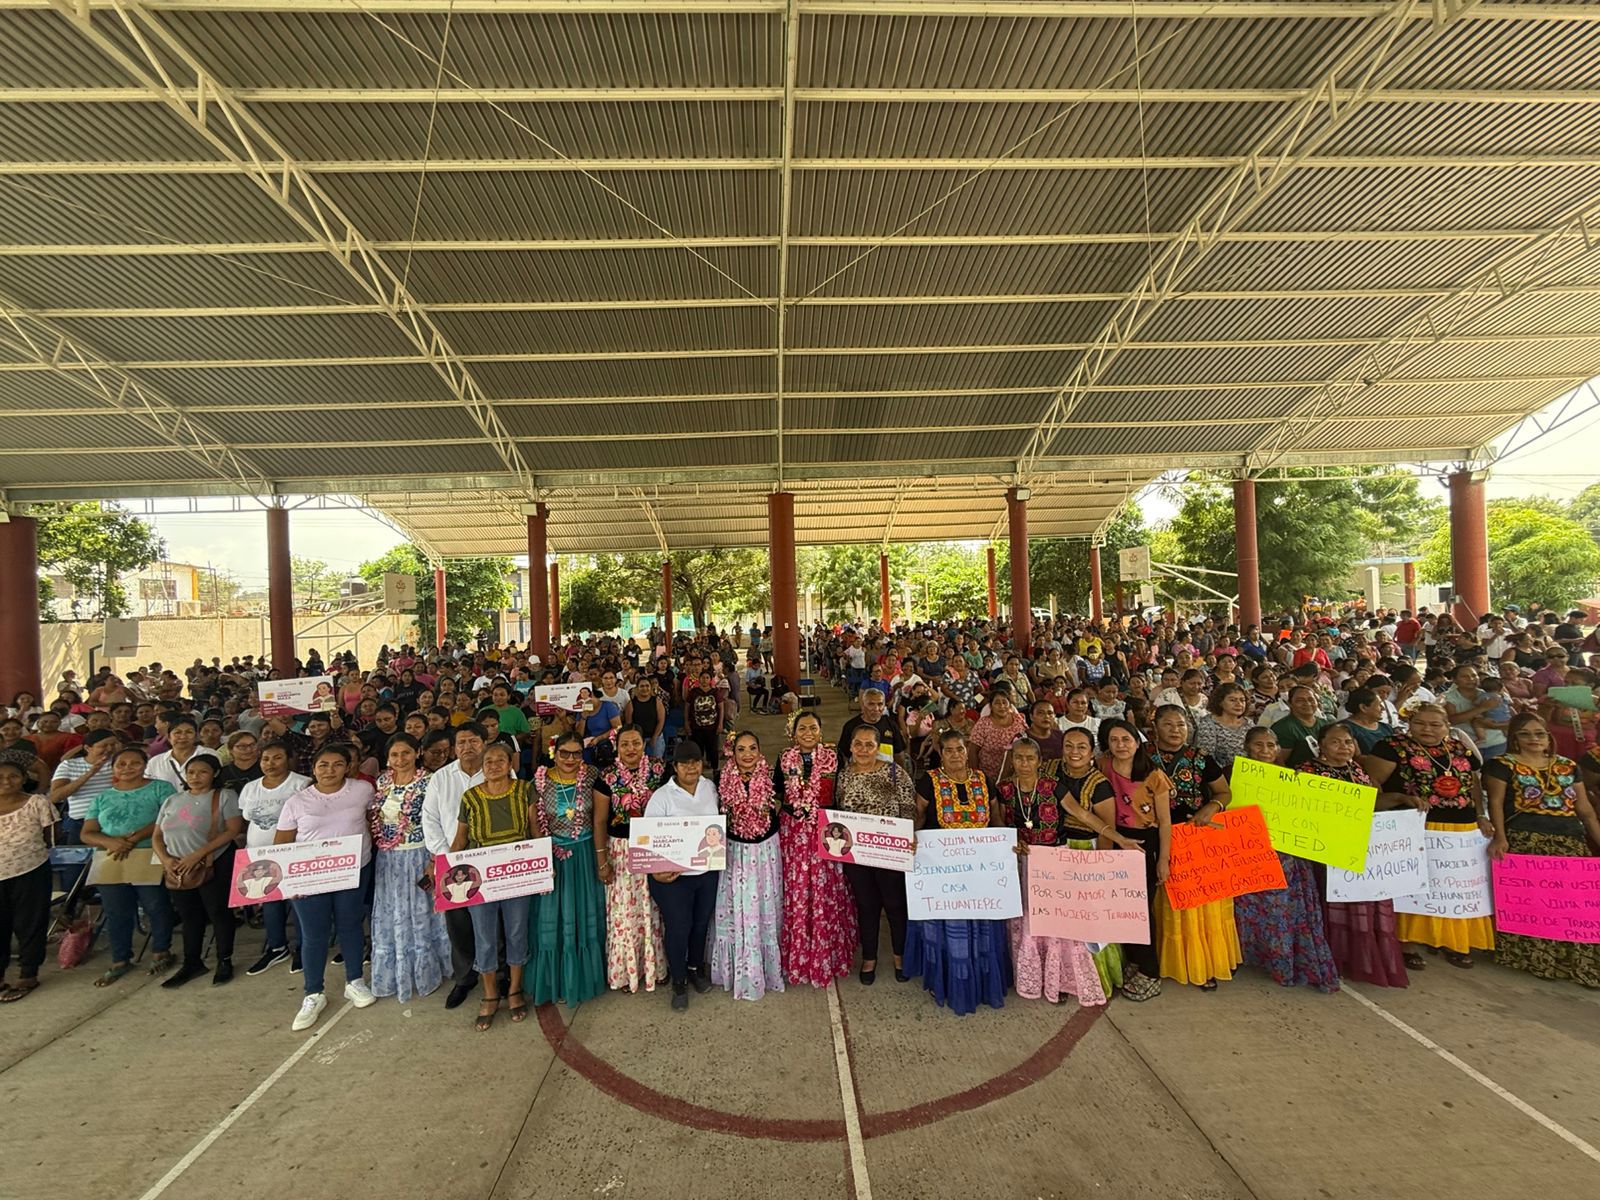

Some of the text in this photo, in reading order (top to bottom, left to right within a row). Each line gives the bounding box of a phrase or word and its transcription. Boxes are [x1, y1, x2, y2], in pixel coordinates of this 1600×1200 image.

[1241, 761, 1361, 799] DRA ANA CECILIA
[1243, 782, 1363, 822] TEHUANTEPEC
[1292, 817, 1319, 833] CON
[1375, 819, 1397, 832] SIGA
[858, 833, 908, 847] $5,000.00
[969, 834, 1007, 844] MARTINEZ
[942, 848, 976, 857] CORTES
[290, 857, 354, 874] $5,000.00
[488, 858, 546, 878] $5,000.00
[913, 862, 1005, 876] BIENVENIDA A SU
[1525, 859, 1568, 871] MUJER
[1063, 870, 1106, 881] SALOMON
[1108, 871, 1129, 881] JARA
[1499, 876, 1535, 888] ESTA
[1539, 879, 1564, 889] CON
[941, 883, 968, 893] CASA
[1031, 884, 1147, 901] POR SU AMOR A TODAS
[921, 896, 1003, 912] TEHUANTEPEC
[1424, 903, 1447, 915] SU
[1032, 907, 1050, 916] LAS
[1055, 908, 1100, 921] MUJERES
[1498, 909, 1538, 925] MUJER
[1543, 916, 1559, 926] DE
